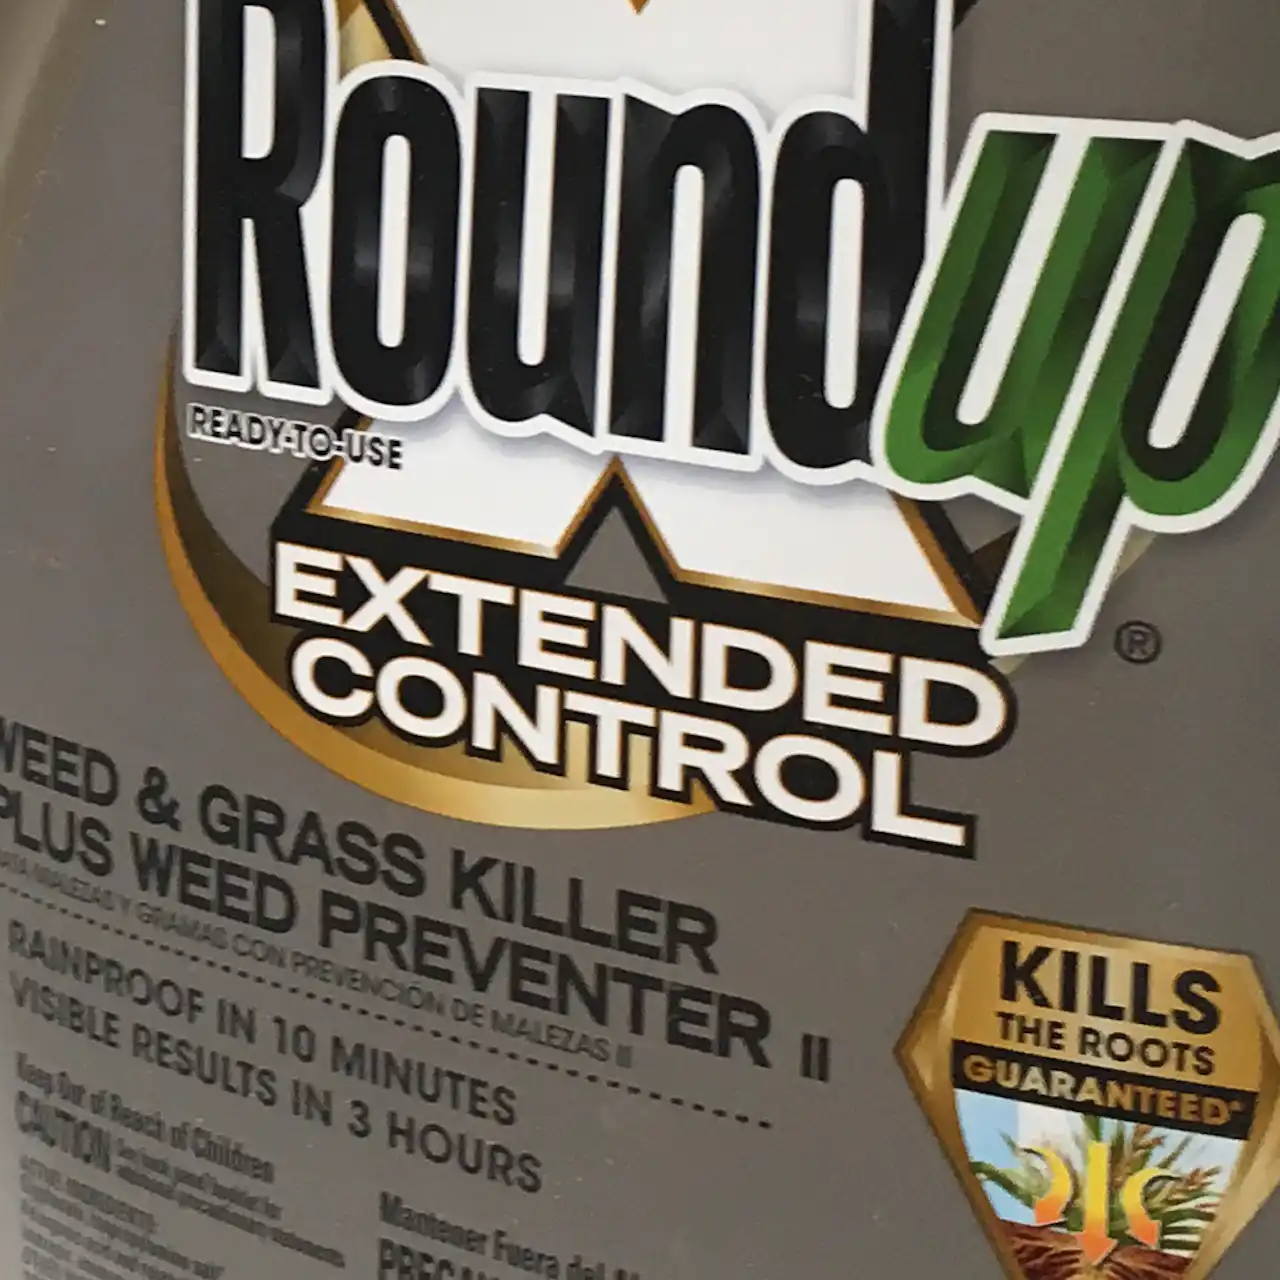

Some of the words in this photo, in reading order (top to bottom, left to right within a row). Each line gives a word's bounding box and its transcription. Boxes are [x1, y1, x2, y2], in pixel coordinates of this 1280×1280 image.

[186, 395, 405, 471] READY-TO-USE
[273, 540, 1010, 749] EXTENDED
[288, 635, 970, 850] CONTROL
[129, 831, 299, 934] WEED
[319, 889, 773, 1070] PREVENTER
[800, 1032, 831, 1082] II
[136, 766, 181, 832] &
[198, 784, 427, 899] GRASS
[450, 849, 719, 975] KILLER
[7, 918, 205, 1024] RAINPROOF
[217, 998, 256, 1047] IN
[273, 1016, 316, 1064] 10
[330, 1036, 518, 1126] MINUTES
[9, 972, 121, 1049] VISIBLE
[131, 1022, 278, 1107] RESULTS
[291, 1079, 332, 1126] IN
[346, 1098, 371, 1138] 3
[387, 1125, 543, 1192] HOURS
[232, 934, 286, 967] CON
[451, 998, 486, 1029] DE
[490, 1010, 611, 1063] MALEZAS
[995, 1010, 1063, 1051] THE
[1077, 1025, 1216, 1077] ROOTS
[1000, 939, 1222, 1035] KILLS
